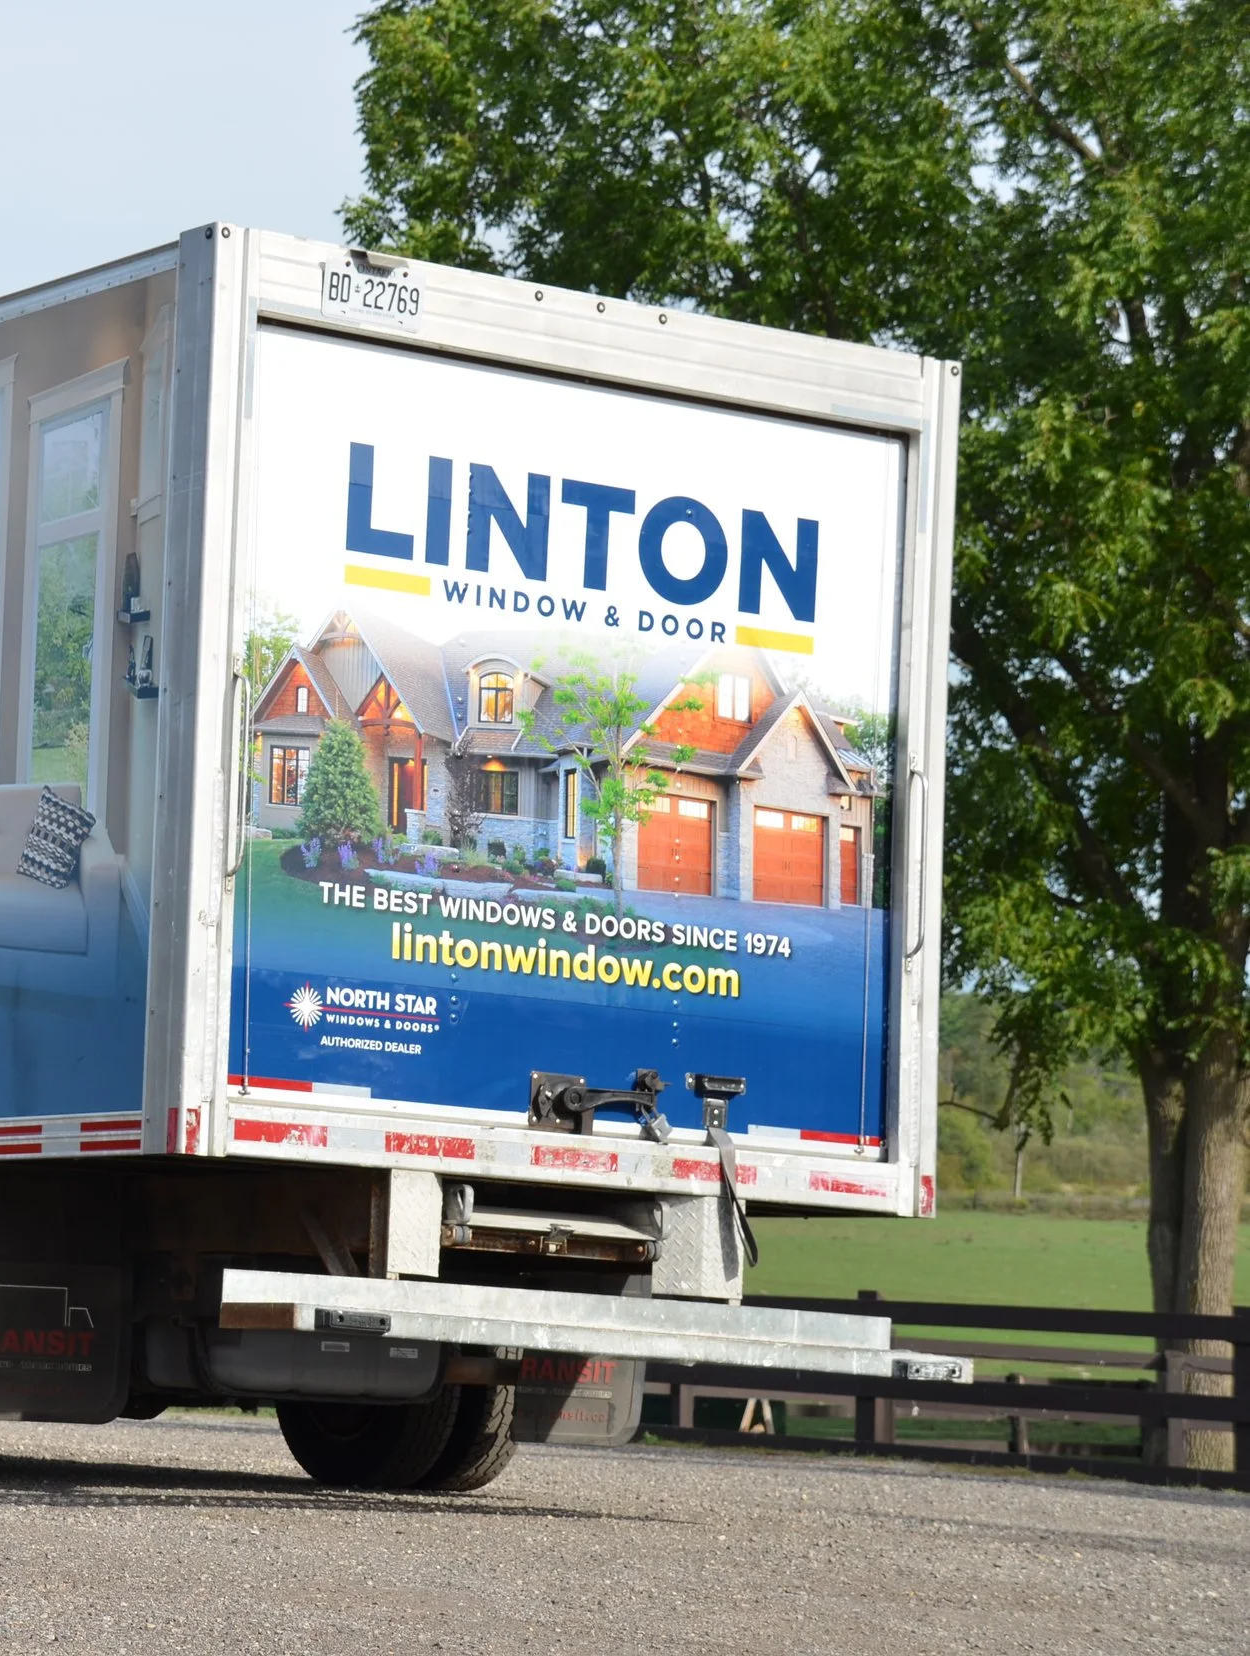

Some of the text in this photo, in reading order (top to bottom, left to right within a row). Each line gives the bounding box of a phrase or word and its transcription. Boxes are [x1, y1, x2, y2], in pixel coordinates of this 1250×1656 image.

[328, 271, 420, 316] BD 22769
[346, 441, 819, 623] LINTON
[443, 579, 726, 644] WINDOW & DOOR
[319, 882, 791, 958] THE BEST WINDOWS & DOORS SINCE 1974
[392, 922, 739, 998] lintonwindow.com
[326, 986, 438, 1016] NORTH STAR
[326, 1014, 380, 1028] WINDOWS
[384, 1020, 391, 1029] &
[320, 1035, 422, 1055] AUTHORIZED DEALER
[519, 1356, 617, 1385] RANSIT
